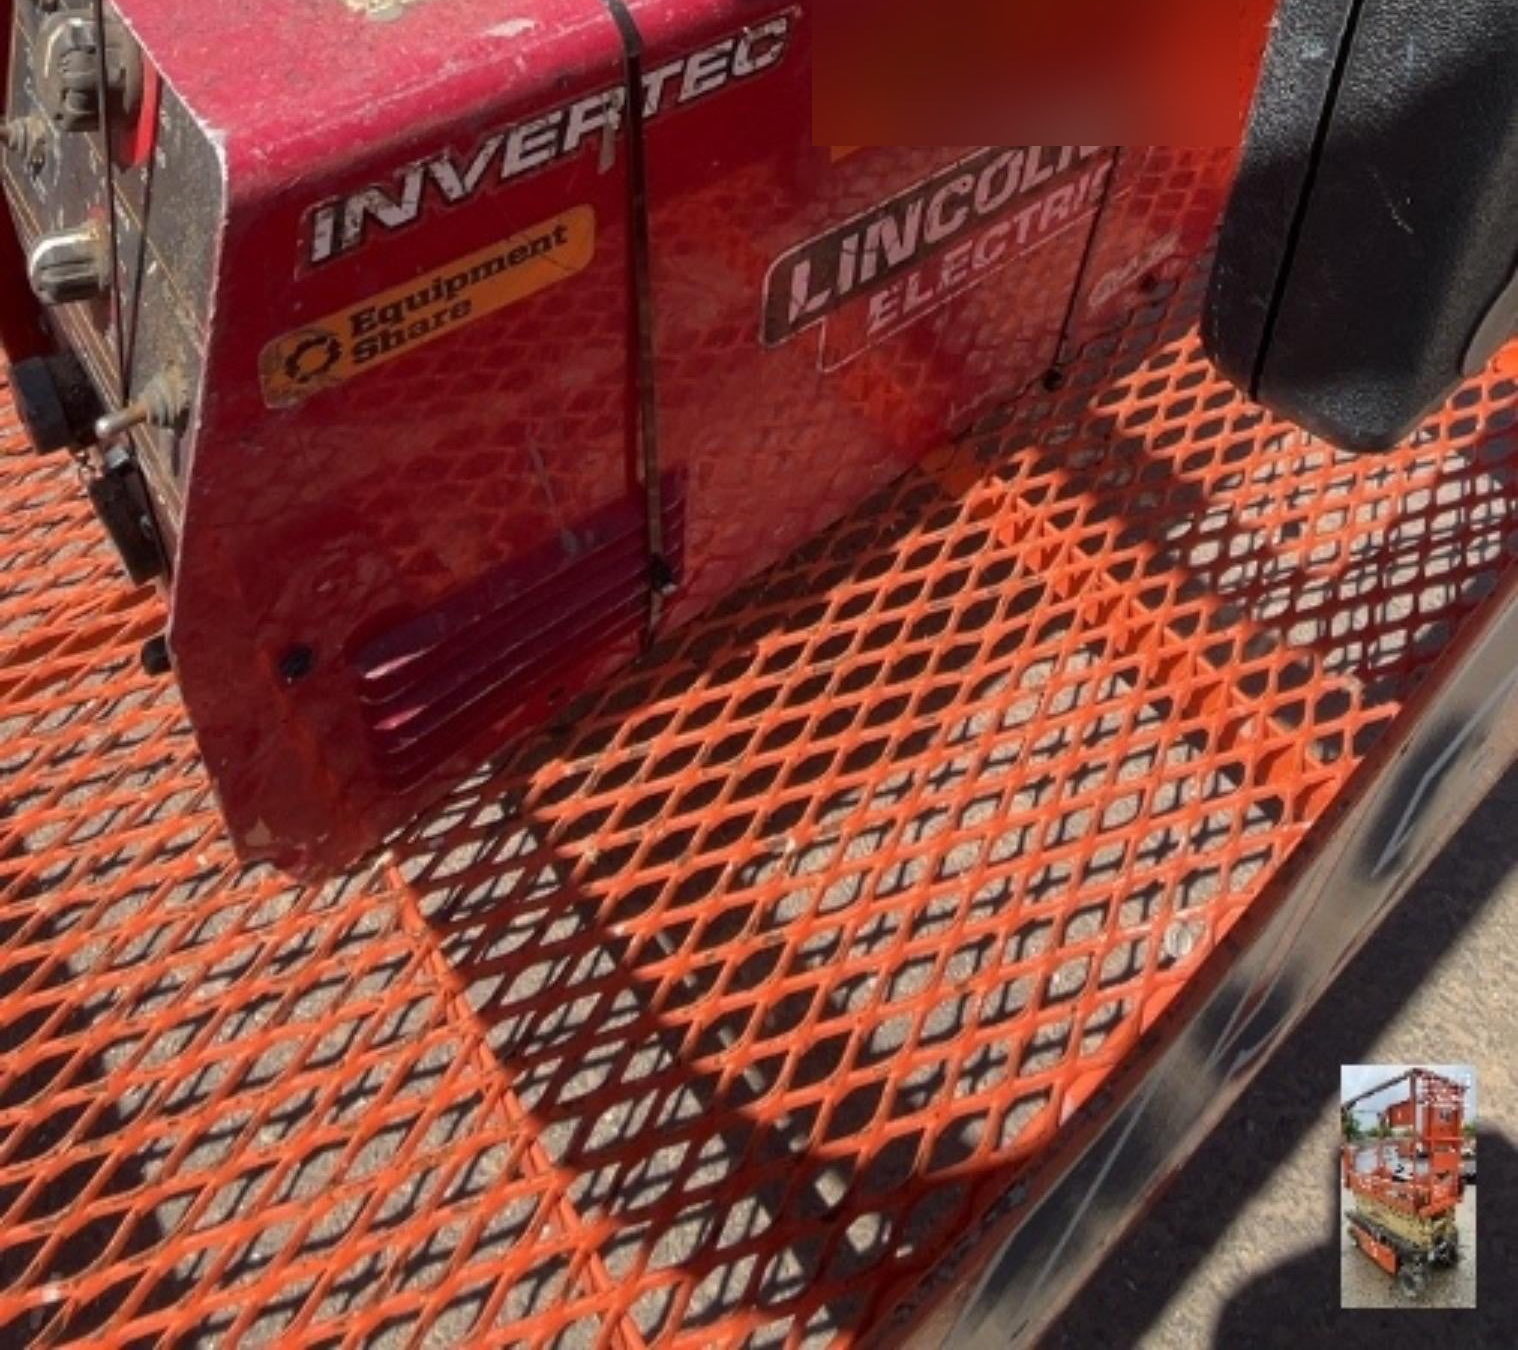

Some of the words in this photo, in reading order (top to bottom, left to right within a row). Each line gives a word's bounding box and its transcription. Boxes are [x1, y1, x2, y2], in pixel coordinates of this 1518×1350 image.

[308, 16, 788, 264] INVERTEC
[347, 223, 570, 340] Equipment
[349, 300, 474, 367] Share
